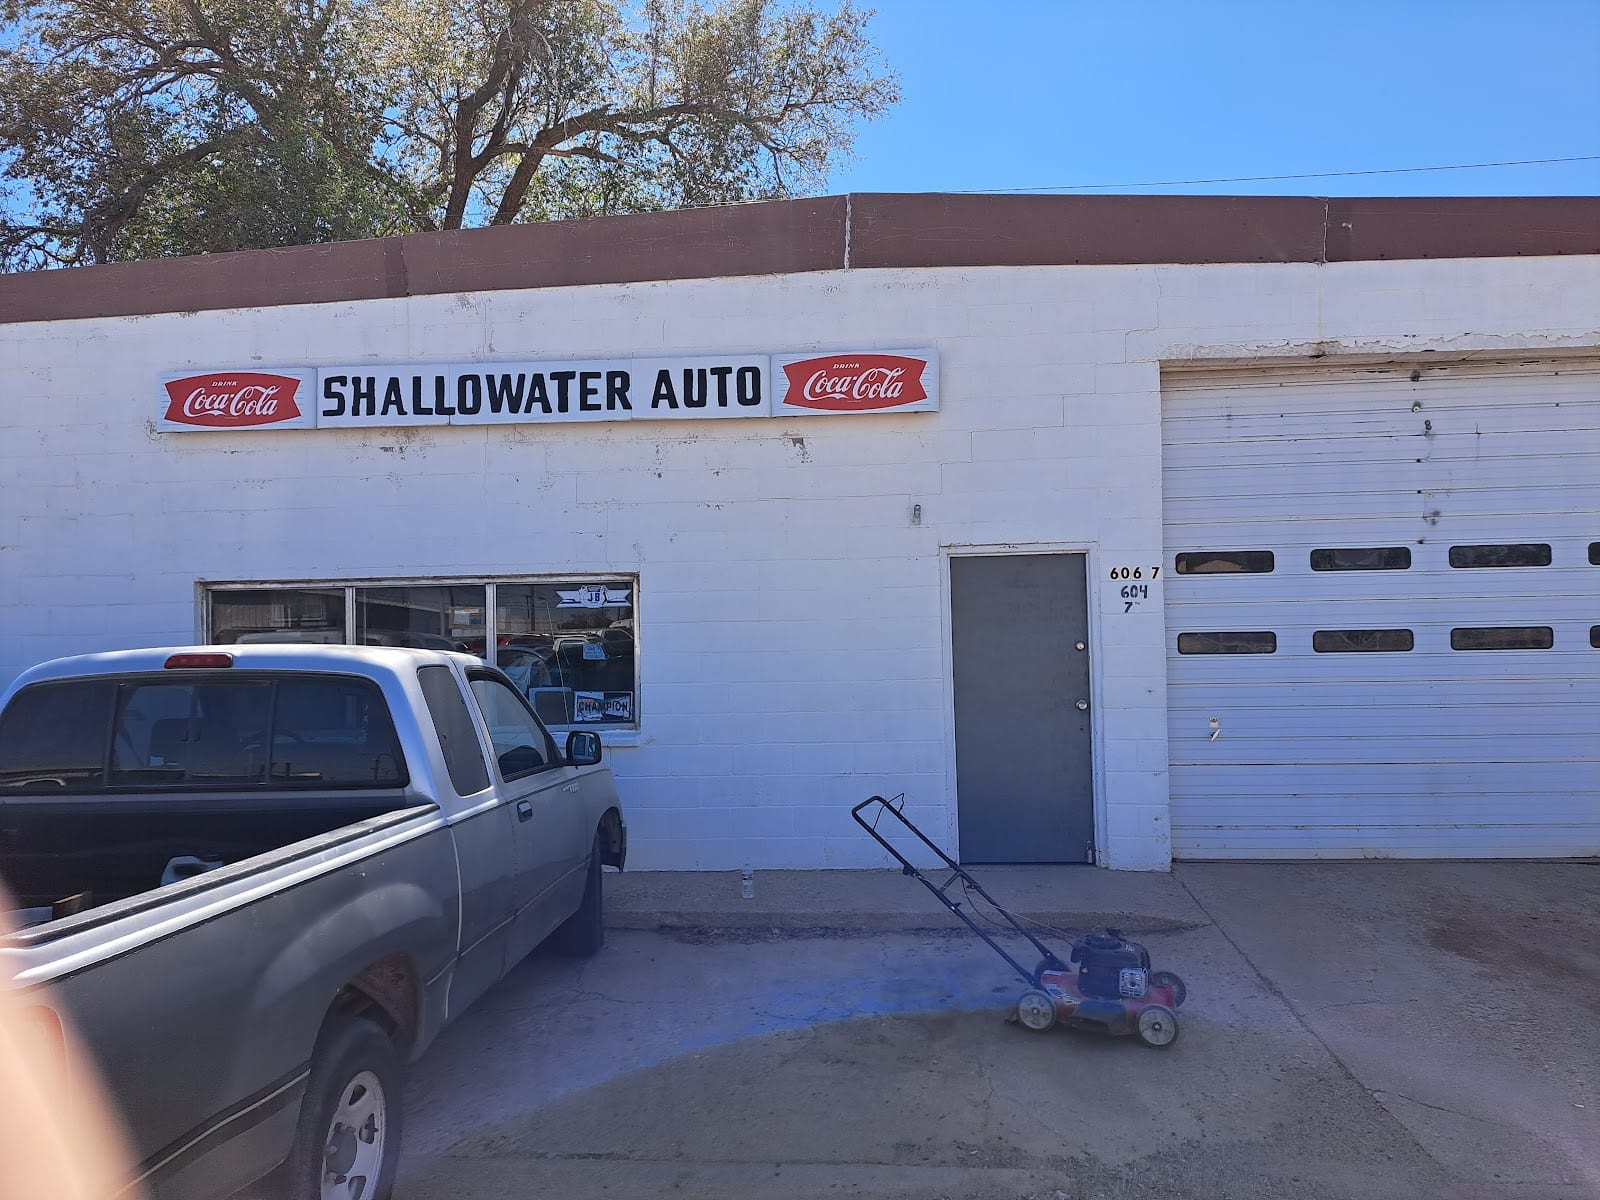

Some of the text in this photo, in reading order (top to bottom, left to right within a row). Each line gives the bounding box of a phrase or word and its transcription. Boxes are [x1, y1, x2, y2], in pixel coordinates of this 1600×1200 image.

[322, 366, 761, 417] SHALLOWATER AUTO
[803, 367, 907, 400] Coca-Cola
[183, 385, 281, 417] Coca-Cola
[1110, 567, 1160, 580] 606 7
[1121, 585, 1148, 599] 604
